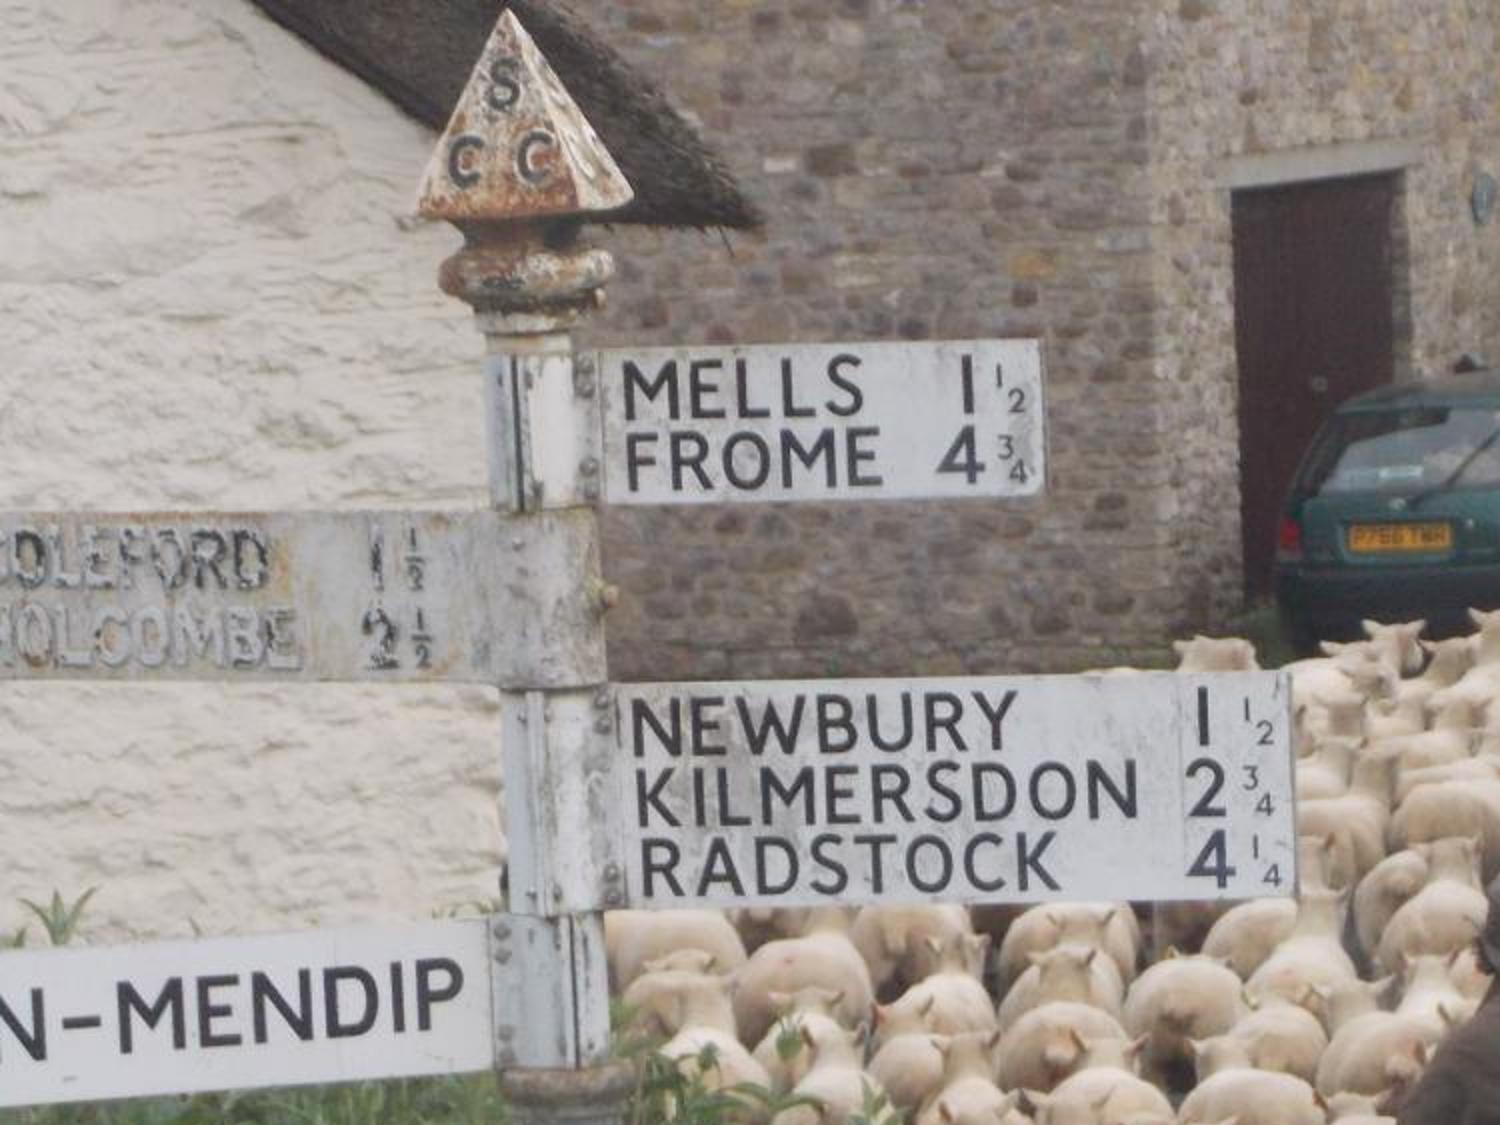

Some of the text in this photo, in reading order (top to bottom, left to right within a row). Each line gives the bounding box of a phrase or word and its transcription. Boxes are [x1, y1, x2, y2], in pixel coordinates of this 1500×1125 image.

[485, 58, 521, 111] S
[449, 131, 553, 188] C C
[622, 353, 864, 420] MELLS
[626, 426, 884, 492] FROME
[935, 424, 986, 484] 4
[0, 529, 269, 590] OLEFORD
[0, 602, 303, 670] OLCOMBE
[362, 603, 400, 671] 2
[631, 690, 1017, 758] NEWBURY
[635, 759, 1138, 828] KILMERSDON
[1186, 757, 1227, 817] 2
[641, 831, 1061, 897] RADSTOCK
[1185, 829, 1237, 889] 4
